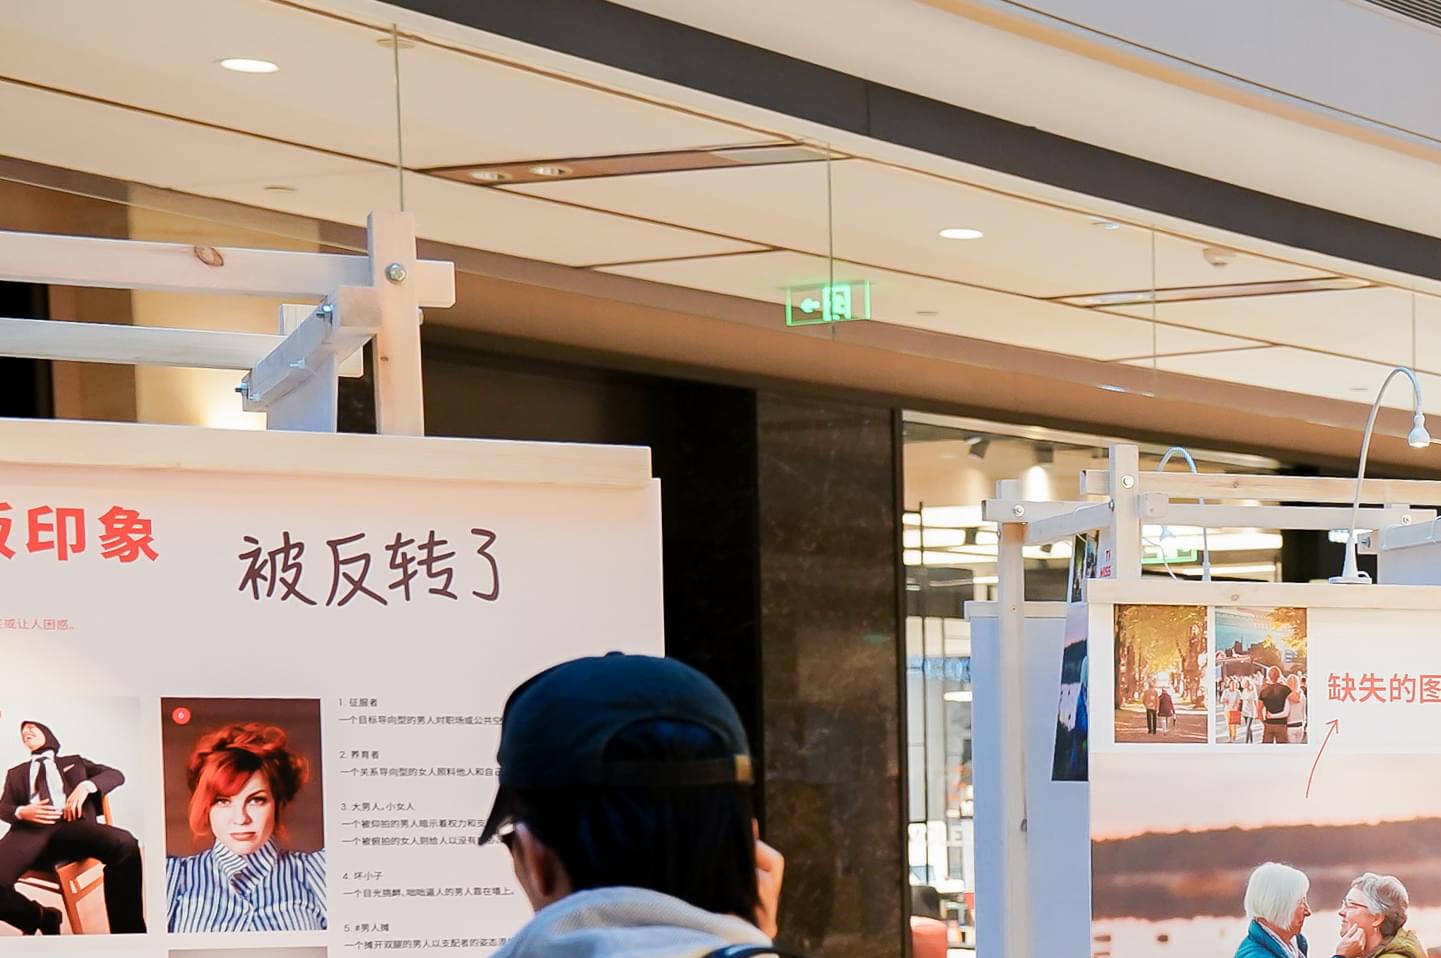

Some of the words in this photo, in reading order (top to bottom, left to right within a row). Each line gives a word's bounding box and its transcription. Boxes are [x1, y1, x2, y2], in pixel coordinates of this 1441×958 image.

[0, 501, 160, 563] 印象
[238, 528, 499, 607] 被反转了
[344, 937, 511, 950] 一个摊开双腿的男人以支配者的姿态
